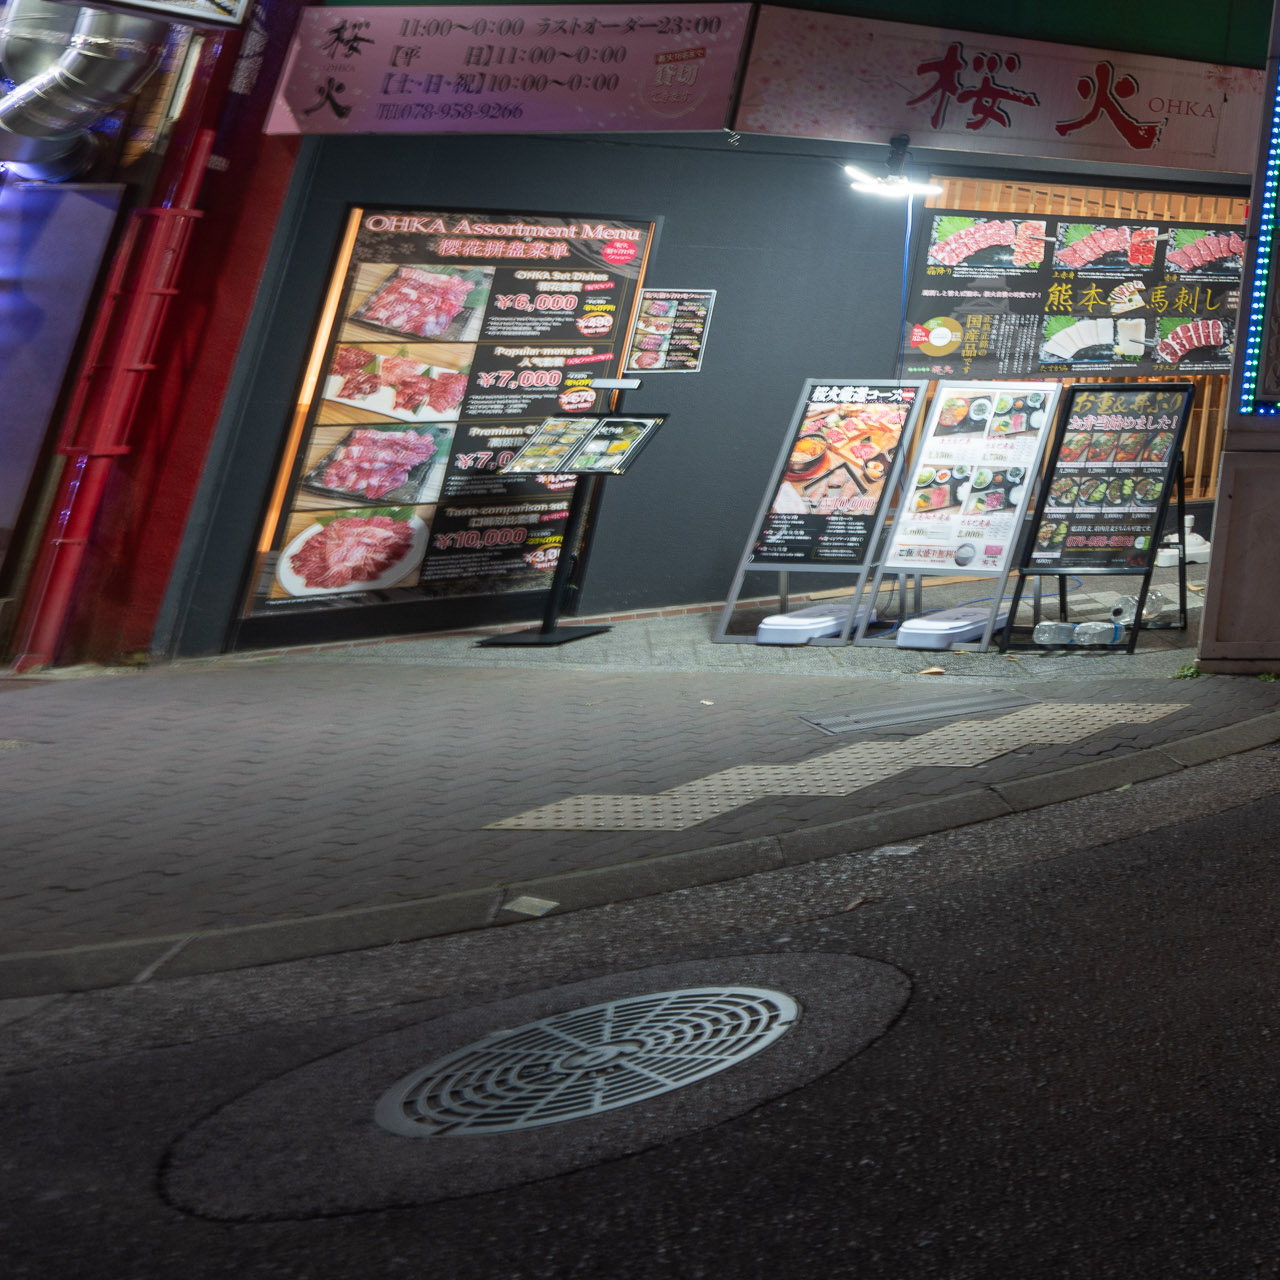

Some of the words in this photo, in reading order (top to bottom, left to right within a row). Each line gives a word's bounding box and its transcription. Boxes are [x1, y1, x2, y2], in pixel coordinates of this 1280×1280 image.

[905, 40, 1170, 151] 桜火
[1147, 96, 1216, 120] OHKA
[365, 214, 447, 234] OHKA
[454, 220, 578, 240] Assortment
[580, 224, 642, 243] Menu
[494, 292, 578, 311] ¥6,000
[1044, 282, 1109, 313] 熊本
[1146, 285, 1222, 315] 馬刺し
[477, 370, 563, 389] ¥7,000
[456, 451, 516, 470] ¥7,0
[433, 528, 528, 551] ¥10,000
